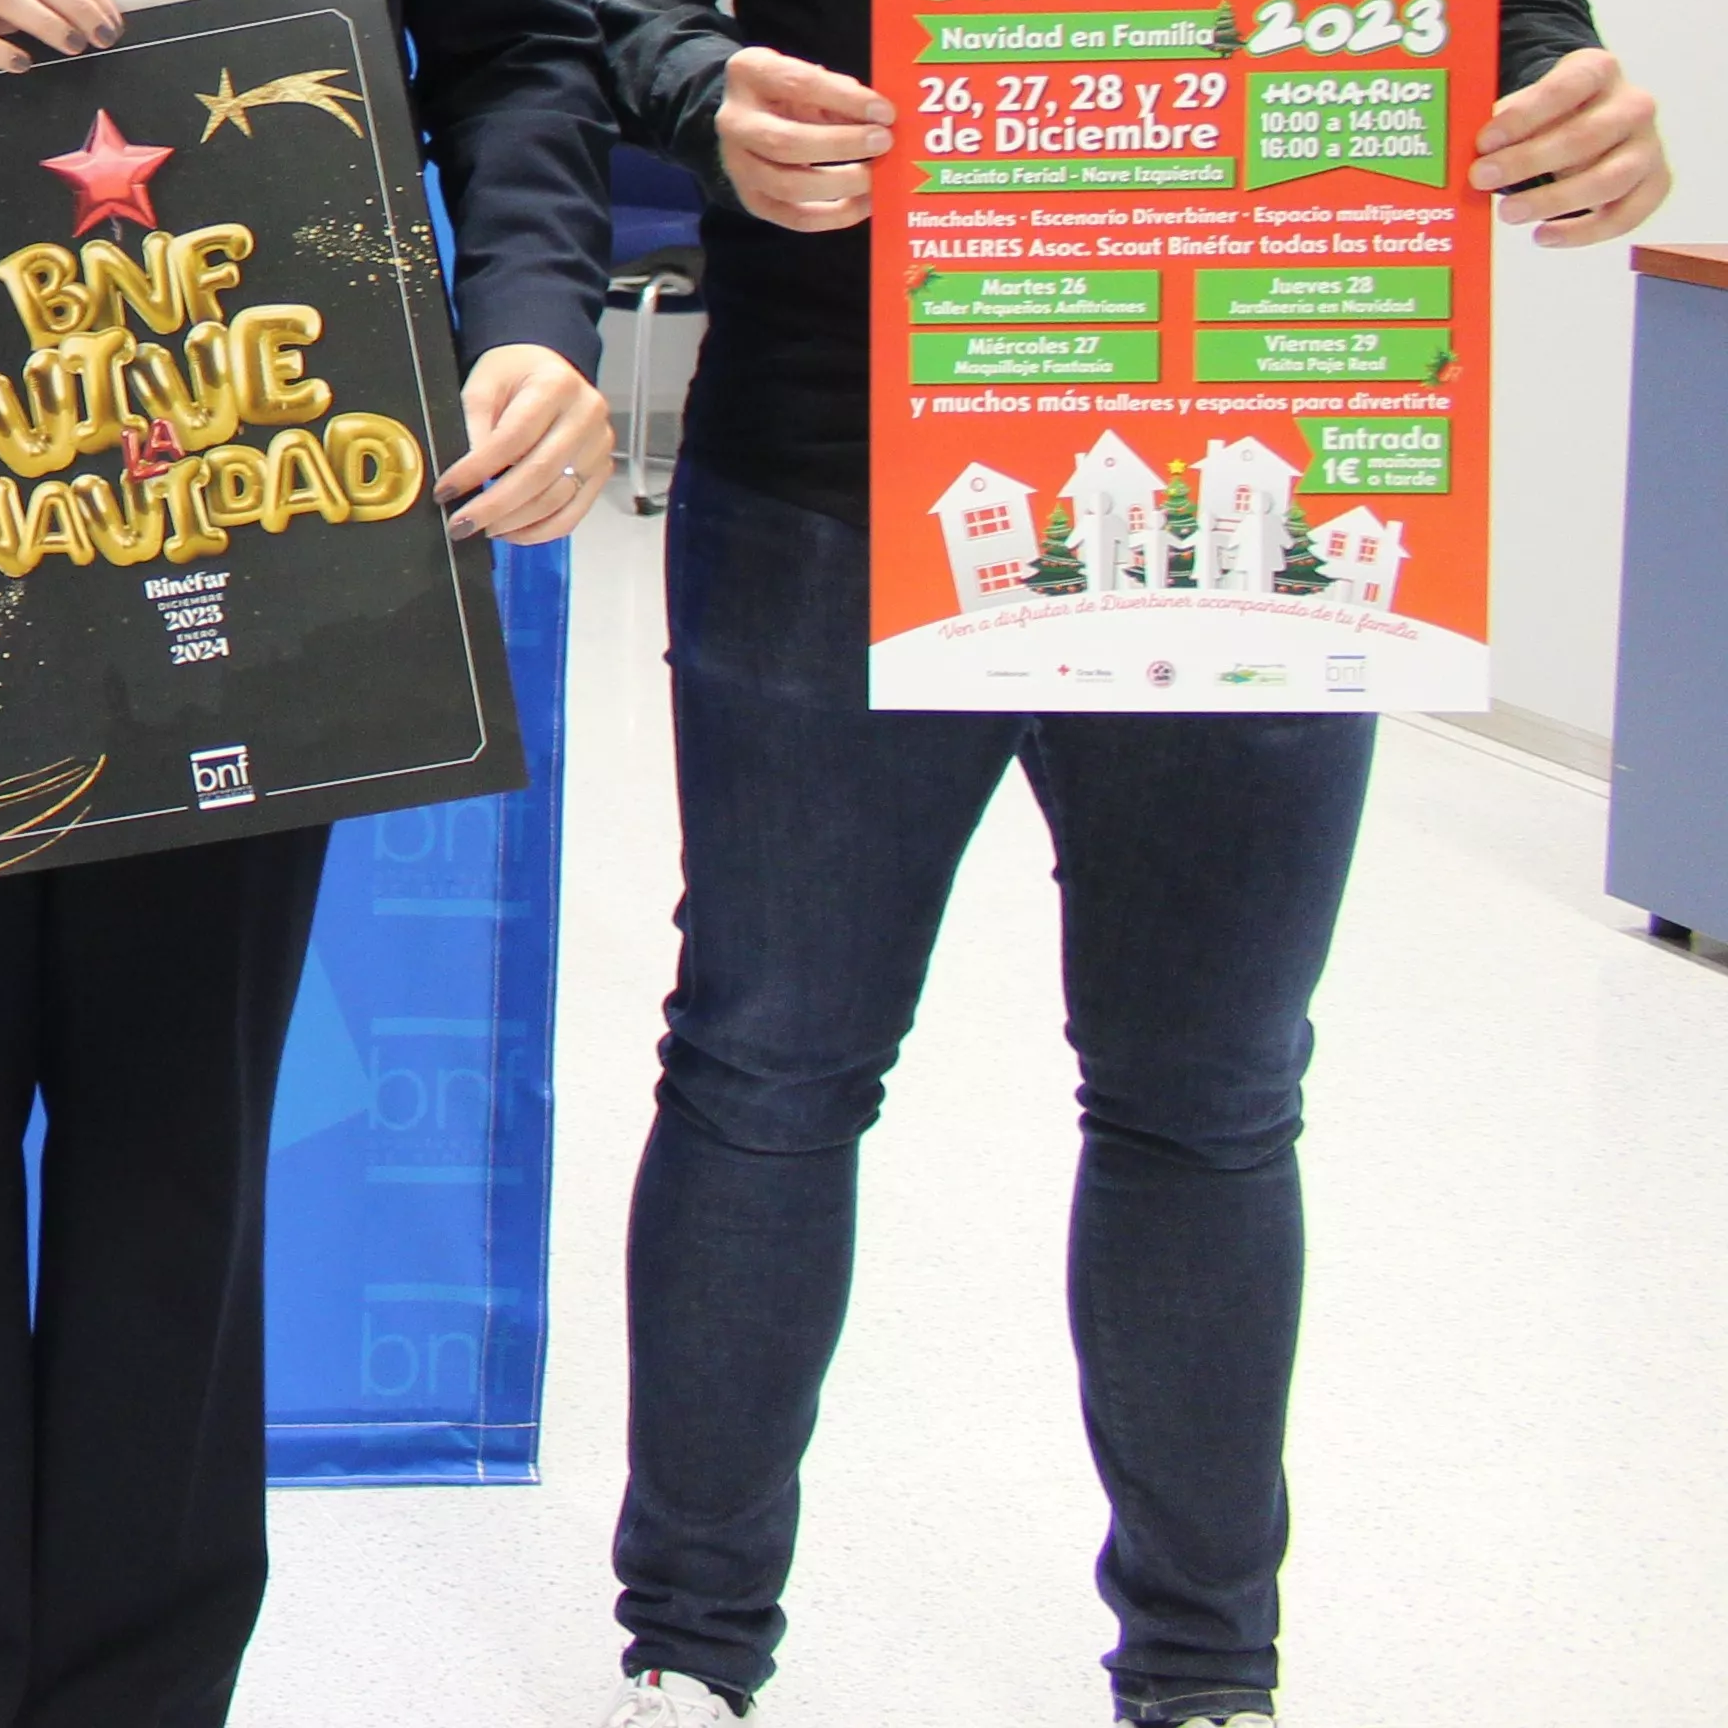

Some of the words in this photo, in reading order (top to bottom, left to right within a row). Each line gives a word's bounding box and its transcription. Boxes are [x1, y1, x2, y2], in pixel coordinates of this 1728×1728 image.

[941, 24, 1063, 50] Navidad
[1071, 31, 1105, 48] en
[1113, 22, 1215, 47] Familia
[917, 76, 984, 118] 26,
[995, 75, 1058, 117] 27,
[1069, 74, 1124, 111] 28
[1134, 83, 1162, 118] y
[1172, 72, 1228, 109] 29
[1261, 79, 1433, 105] HORARIO:
[924, 116, 983, 153] de
[995, 113, 1220, 152] Diciembre
[1260, 111, 1319, 133] 10:00
[1326, 116, 1341, 133] a
[1260, 137, 1319, 159] 16:00
[1326, 142, 1341, 158] a
[907, 209, 1016, 227] Hinchables
[1031, 208, 1127, 226] Escenario
[1132, 207, 1238, 225] Diverbiner
[1253, 207, 1331, 226] Espacio
[1336, 204, 1454, 224] multijuegos
[909, 238, 1023, 258] TALLERES
[1028, 239, 1092, 258] Asoc.
[1096, 237, 1162, 256] Scout
[1167, 235, 1254, 255] Binéfar
[1259, 234, 1328, 254] todas
[1333, 233, 1368, 253] las
[1372, 232, 1452, 253] tardes
[981, 279, 1056, 295] Martes
[1060, 278, 1087, 294] 26
[1269, 277, 1342, 294] Jueves
[1346, 276, 1374, 294] 28
[968, 337, 1070, 355] Miércoles
[1073, 337, 1100, 353] 27
[1264, 335, 1346, 352] Viernes
[1350, 334, 1378, 351] 29
[910, 397, 926, 418] y
[932, 389, 1031, 413] muchos
[1037, 389, 1091, 412] más
[1095, 394, 1175, 411] talleres
[1178, 398, 1193, 414] y
[1195, 393, 1289, 413] espacios
[1292, 397, 1343, 413] para
[1347, 392, 1451, 411] divertirte
[119, 419, 185, 481] LA
[1321, 425, 1442, 450] Entrada
[1322, 457, 1361, 485] 1€
[1367, 474, 1381, 486] o
[1384, 471, 1437, 486] tarde
[144, 571, 231, 600] Binéfar
[163, 604, 224, 631] 2023
[170, 637, 230, 665] 2024
[191, 753, 253, 796] bnf
